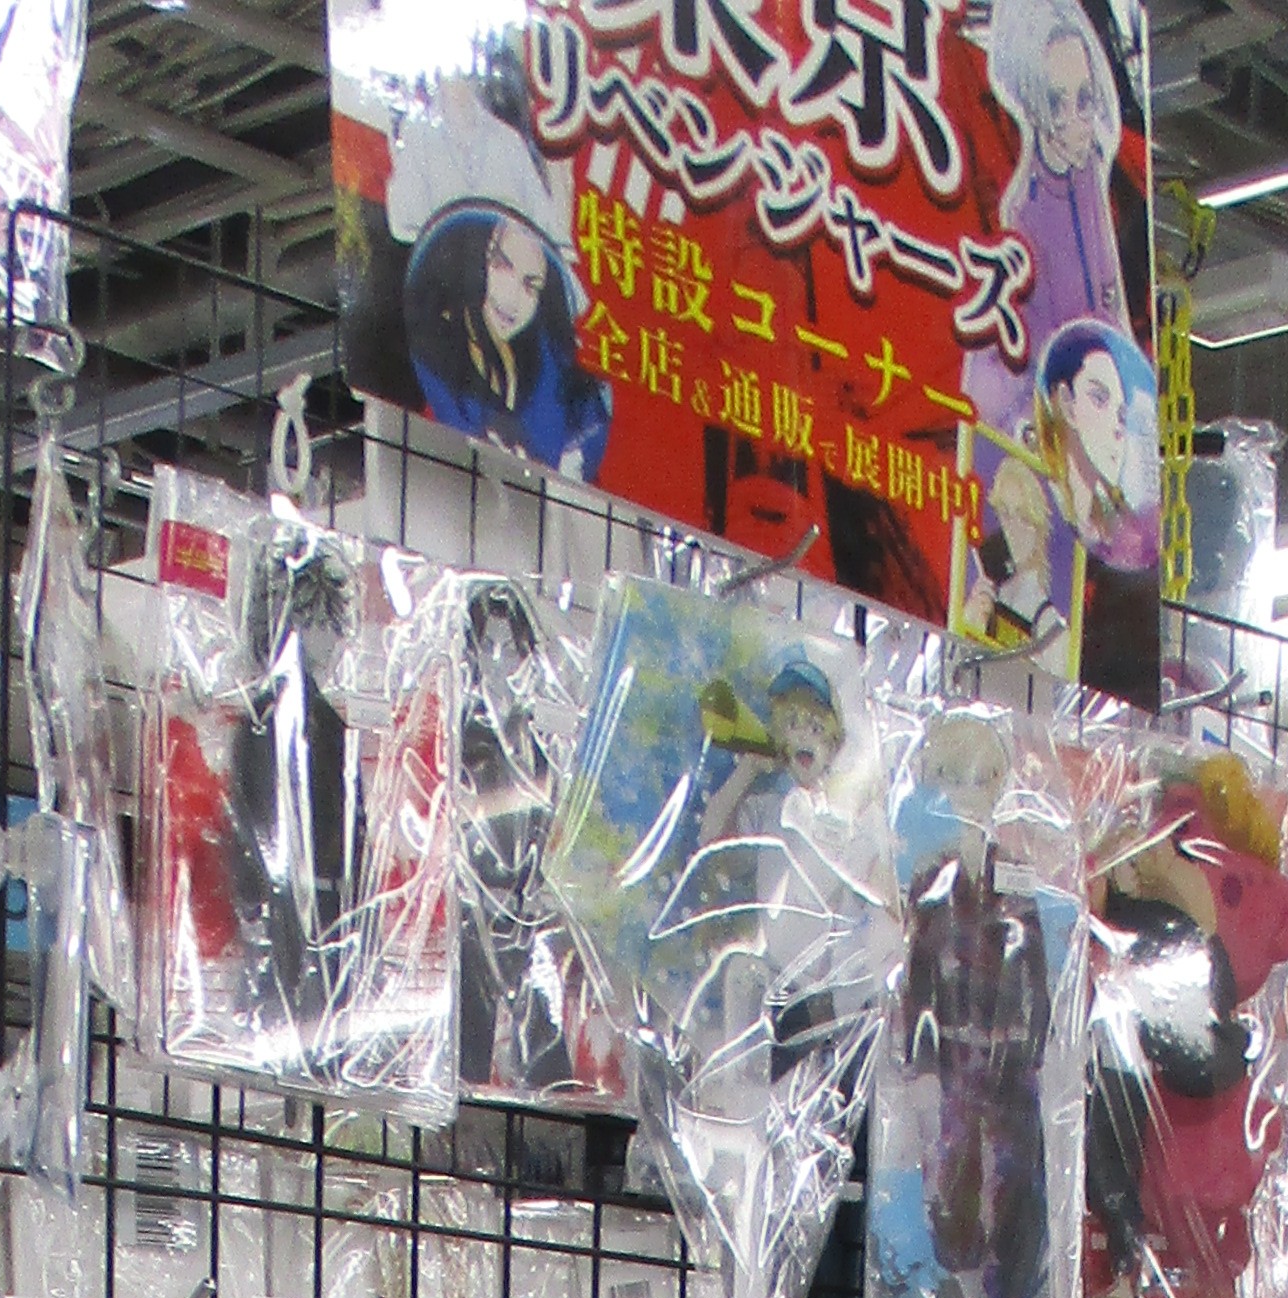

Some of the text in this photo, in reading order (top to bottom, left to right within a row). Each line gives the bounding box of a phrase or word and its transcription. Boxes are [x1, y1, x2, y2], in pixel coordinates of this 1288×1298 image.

[530, 14, 1034, 360] リベンジャーズ
[578, 193, 976, 420] 特設コーナー
